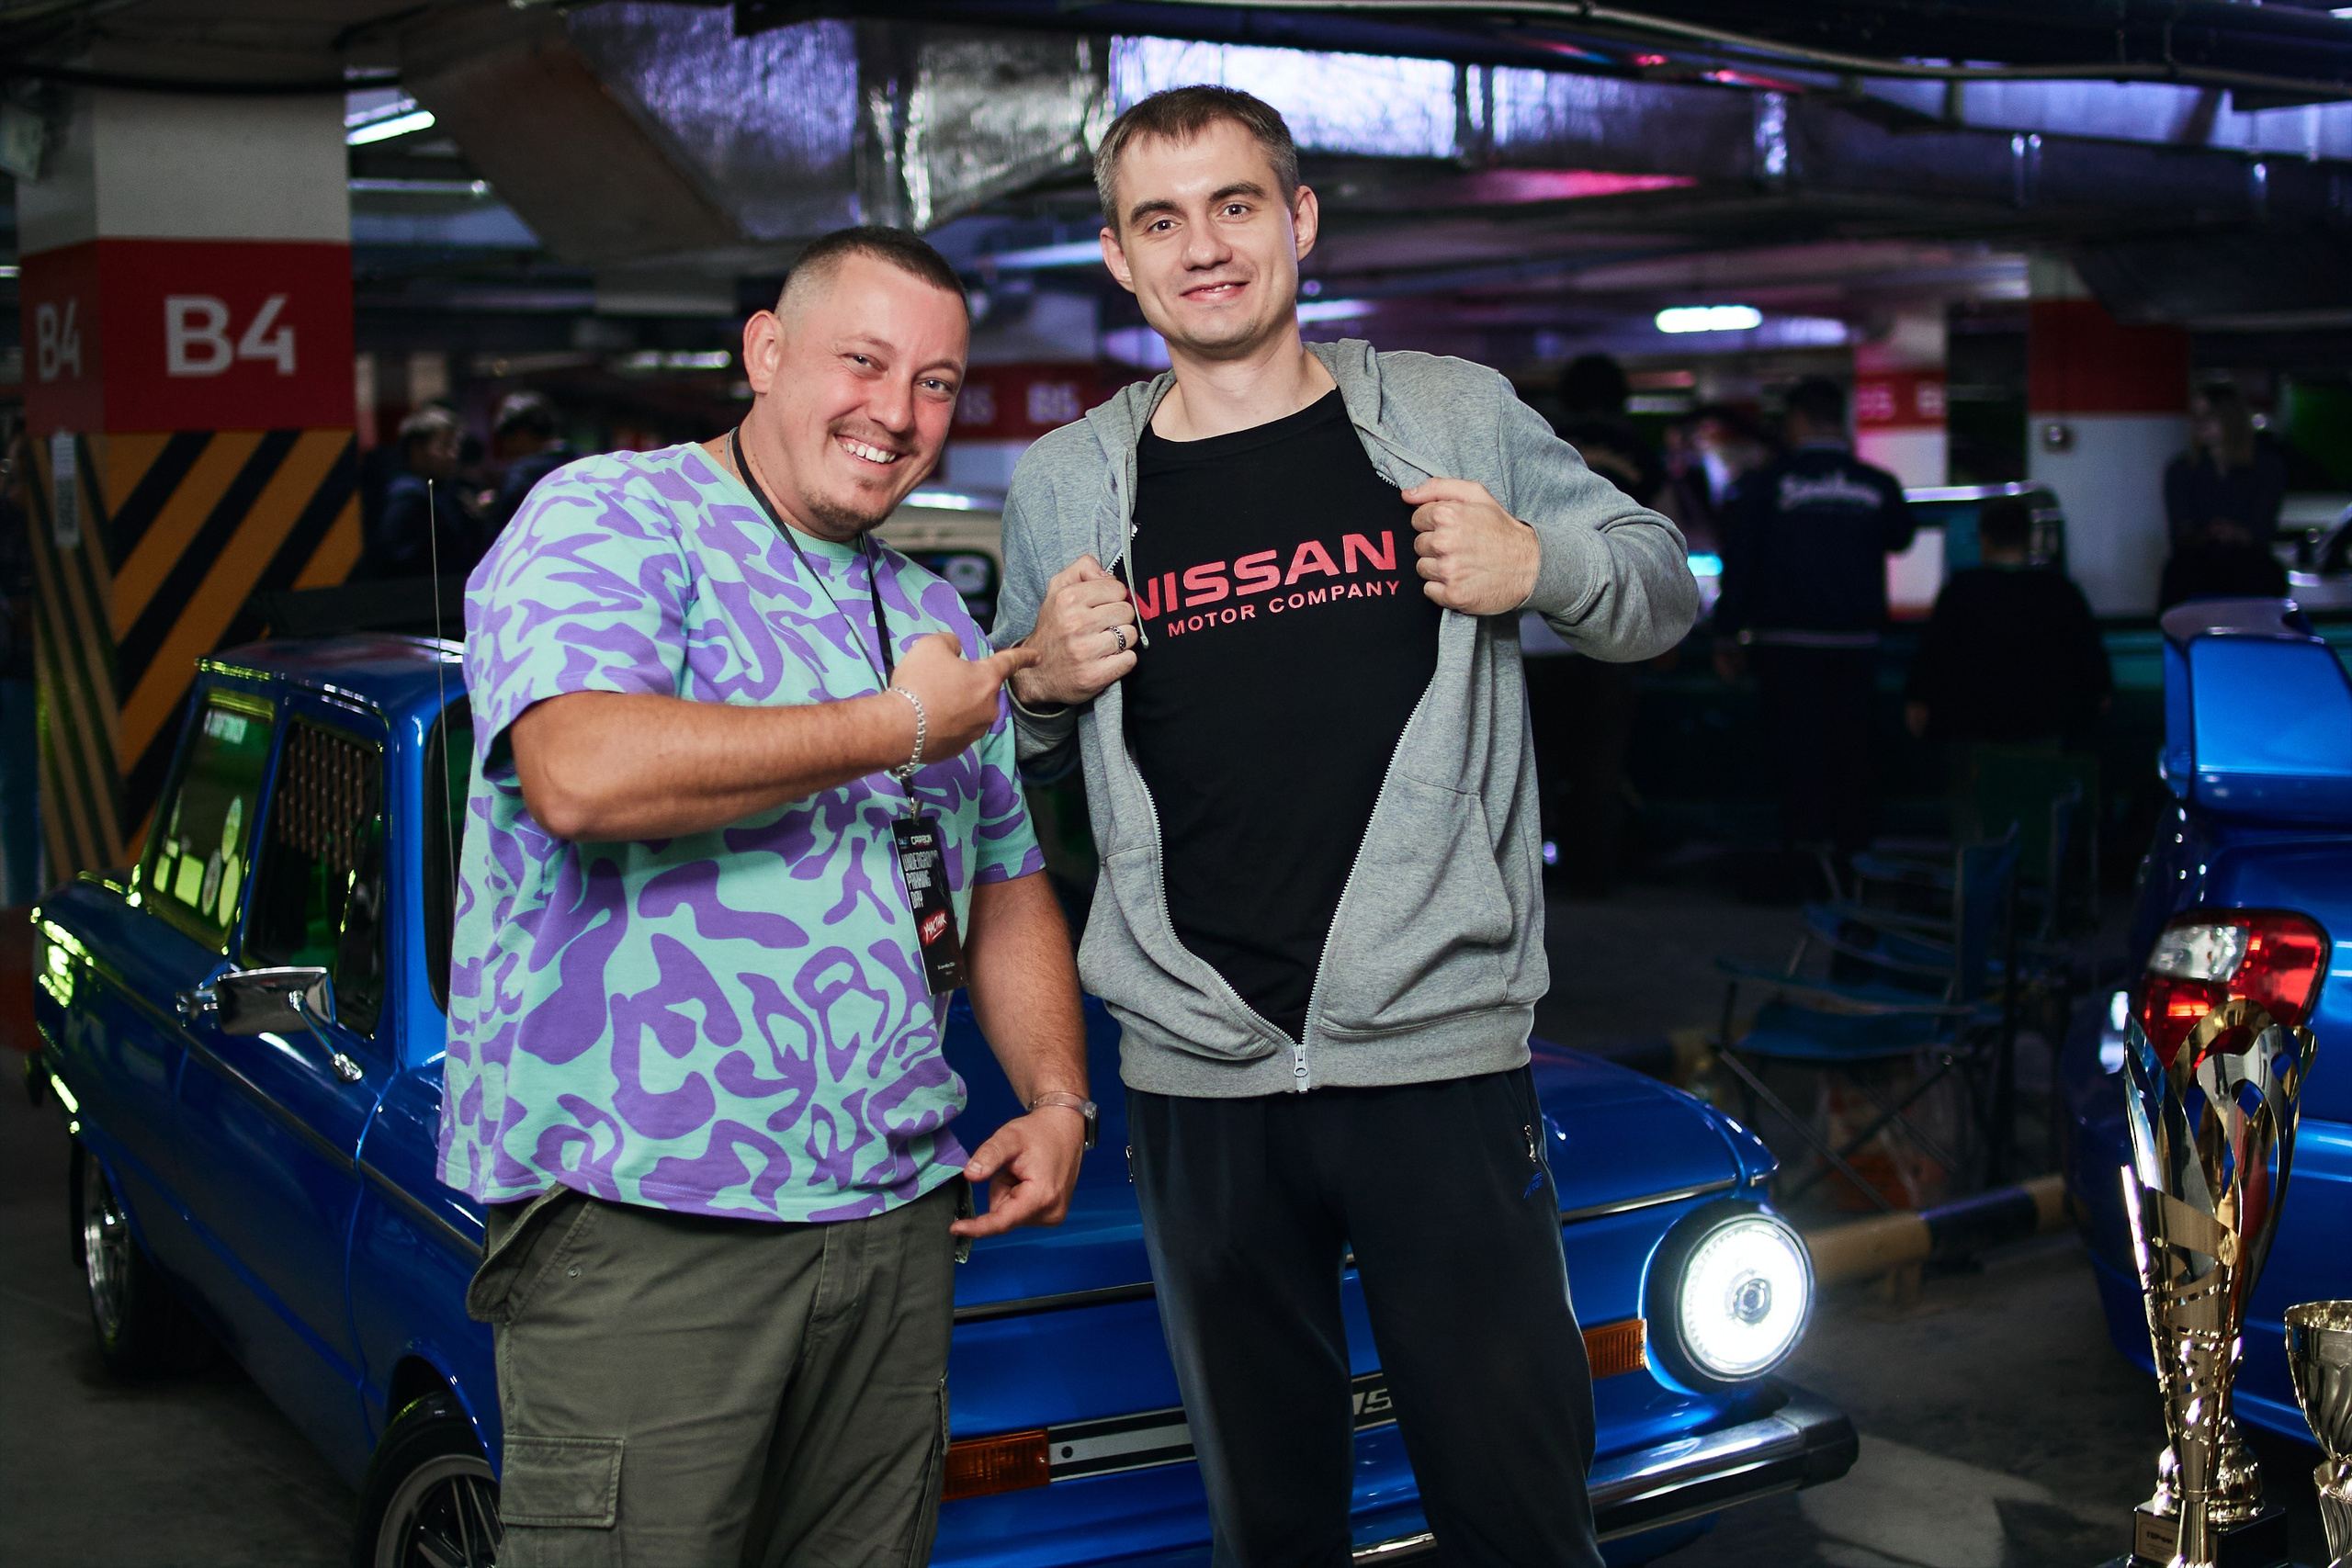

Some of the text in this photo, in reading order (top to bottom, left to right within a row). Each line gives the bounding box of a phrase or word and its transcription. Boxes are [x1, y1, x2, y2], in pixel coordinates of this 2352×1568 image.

[37, 298, 81, 381] B4
[164, 292, 297, 378] B4
[1126, 530, 1396, 621] NISSAN
[1168, 581, 1400, 637] MOTOR COMPANY
